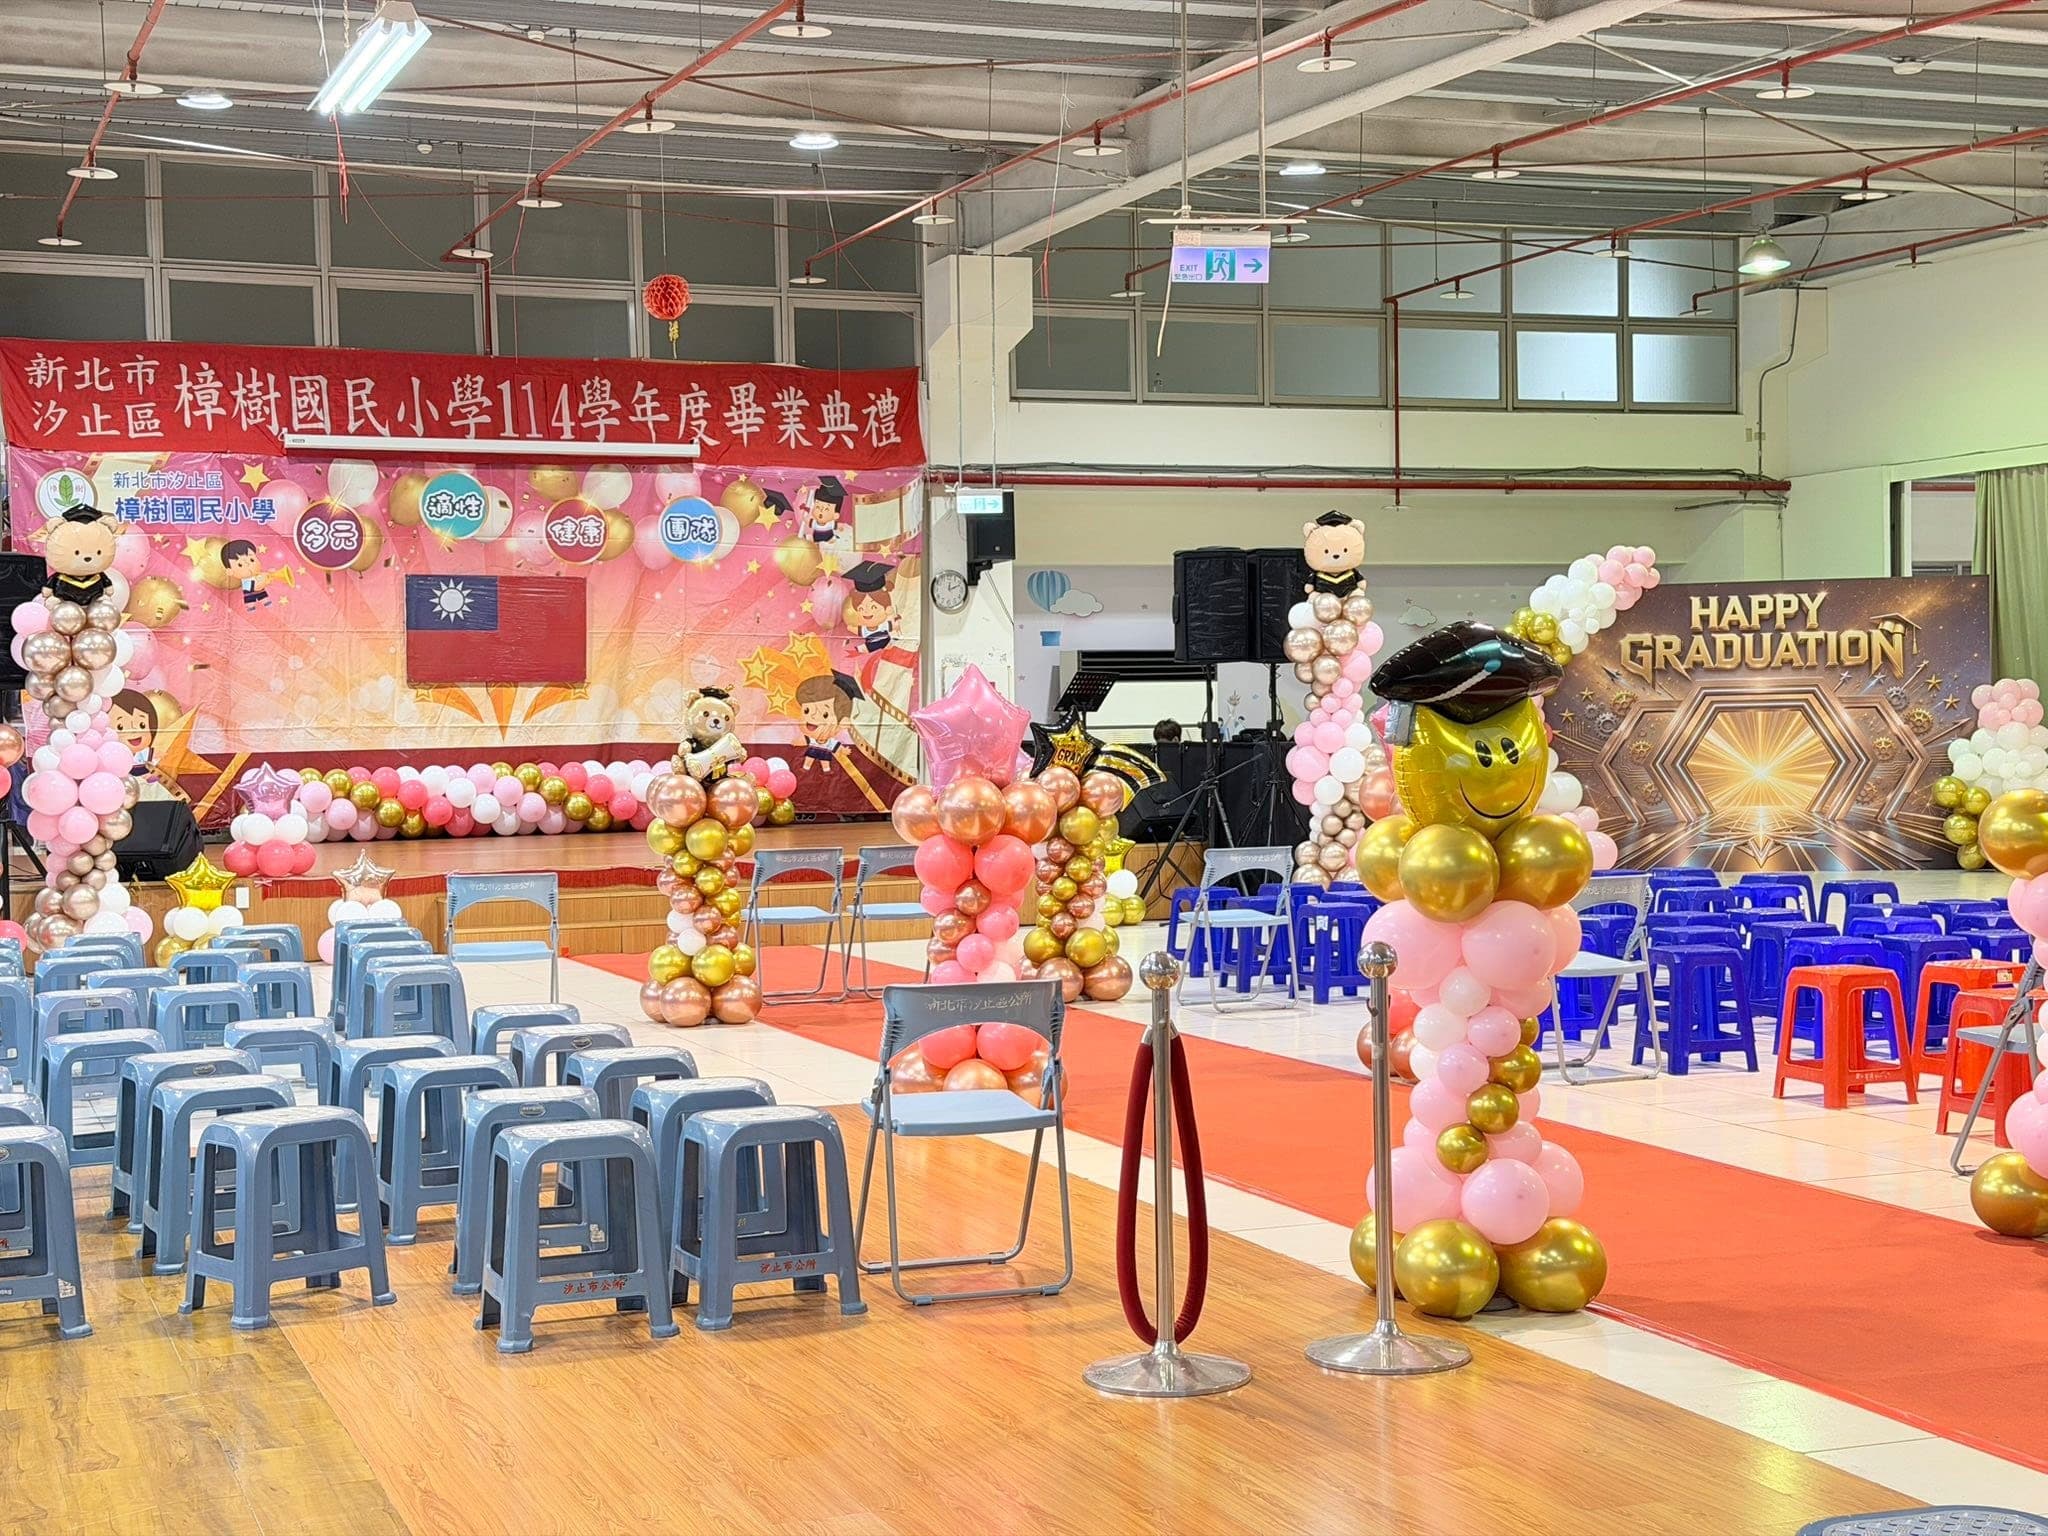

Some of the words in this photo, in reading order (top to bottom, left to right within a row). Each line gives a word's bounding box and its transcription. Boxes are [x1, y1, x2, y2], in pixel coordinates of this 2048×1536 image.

[1179, 264, 1198, 272] EXIT
[24, 352, 160, 396] 新北市
[31, 401, 164, 439] 汐止區
[175, 363, 901, 449] 樟樹國民小學114學年度畢業典禮
[112, 471, 223, 490] 新北市汐止區
[115, 496, 277, 525] 樟樹國民小學
[426, 491, 485, 519] 適性
[301, 518, 359, 550] 多元
[549, 517, 604, 548] 健康
[665, 516, 718, 545] 團隊
[1690, 593, 1827, 630] HAPPY
[1620, 630, 1905, 683] GRADUATION
[760, 1259, 817, 1273] 汐止市公所
